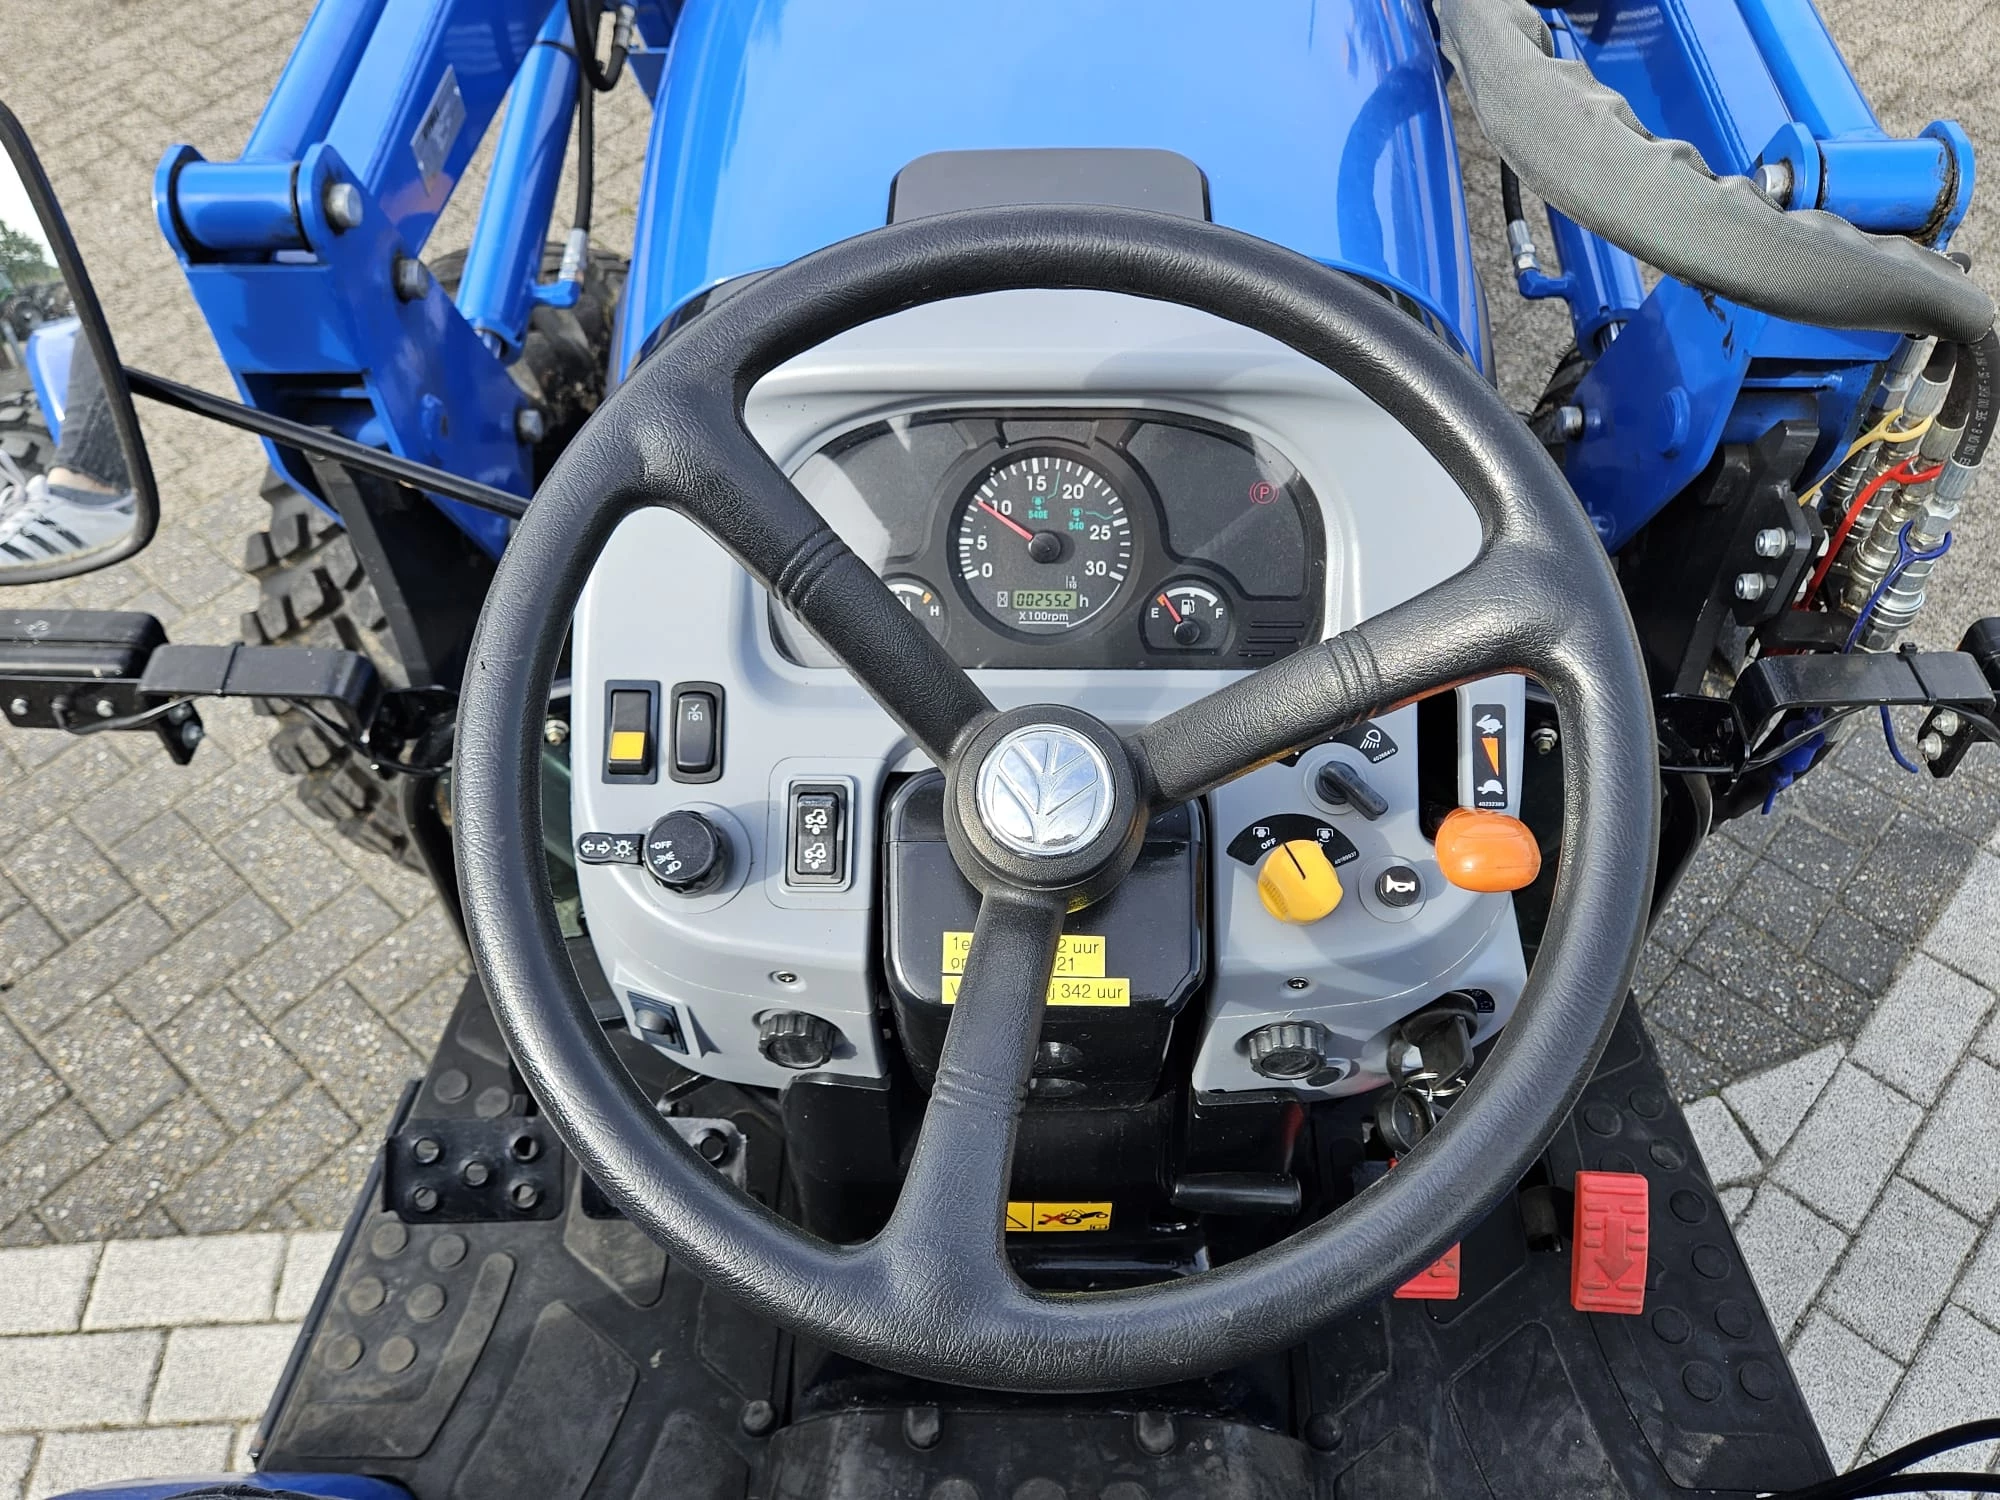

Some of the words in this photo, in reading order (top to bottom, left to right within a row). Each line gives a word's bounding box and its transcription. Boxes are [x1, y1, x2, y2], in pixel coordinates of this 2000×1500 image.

[1026, 476, 1047, 491] 15
[1062, 484, 1084, 500] 20
[991, 500, 1012, 516] 10
[1028, 510, 1049, 519] 540E
[1068, 521, 1085, 530] 540
[1089, 525, 1111, 540] 25
[977, 535, 988, 550] 5
[982, 563, 993, 577] 0
[1085, 561, 1107, 576] 30
[1080, 594, 1089, 608] h
[930, 605, 939, 617] H
[1151, 607, 1159, 618] E
[1216, 607, 1224, 619] F
[654, 840, 672, 849] OFF
[1261, 837, 1277, 850] OFF
[1073, 943, 1099, 954] uur
[1061, 983, 1092, 998] 342
[1097, 987, 1123, 999] uur
